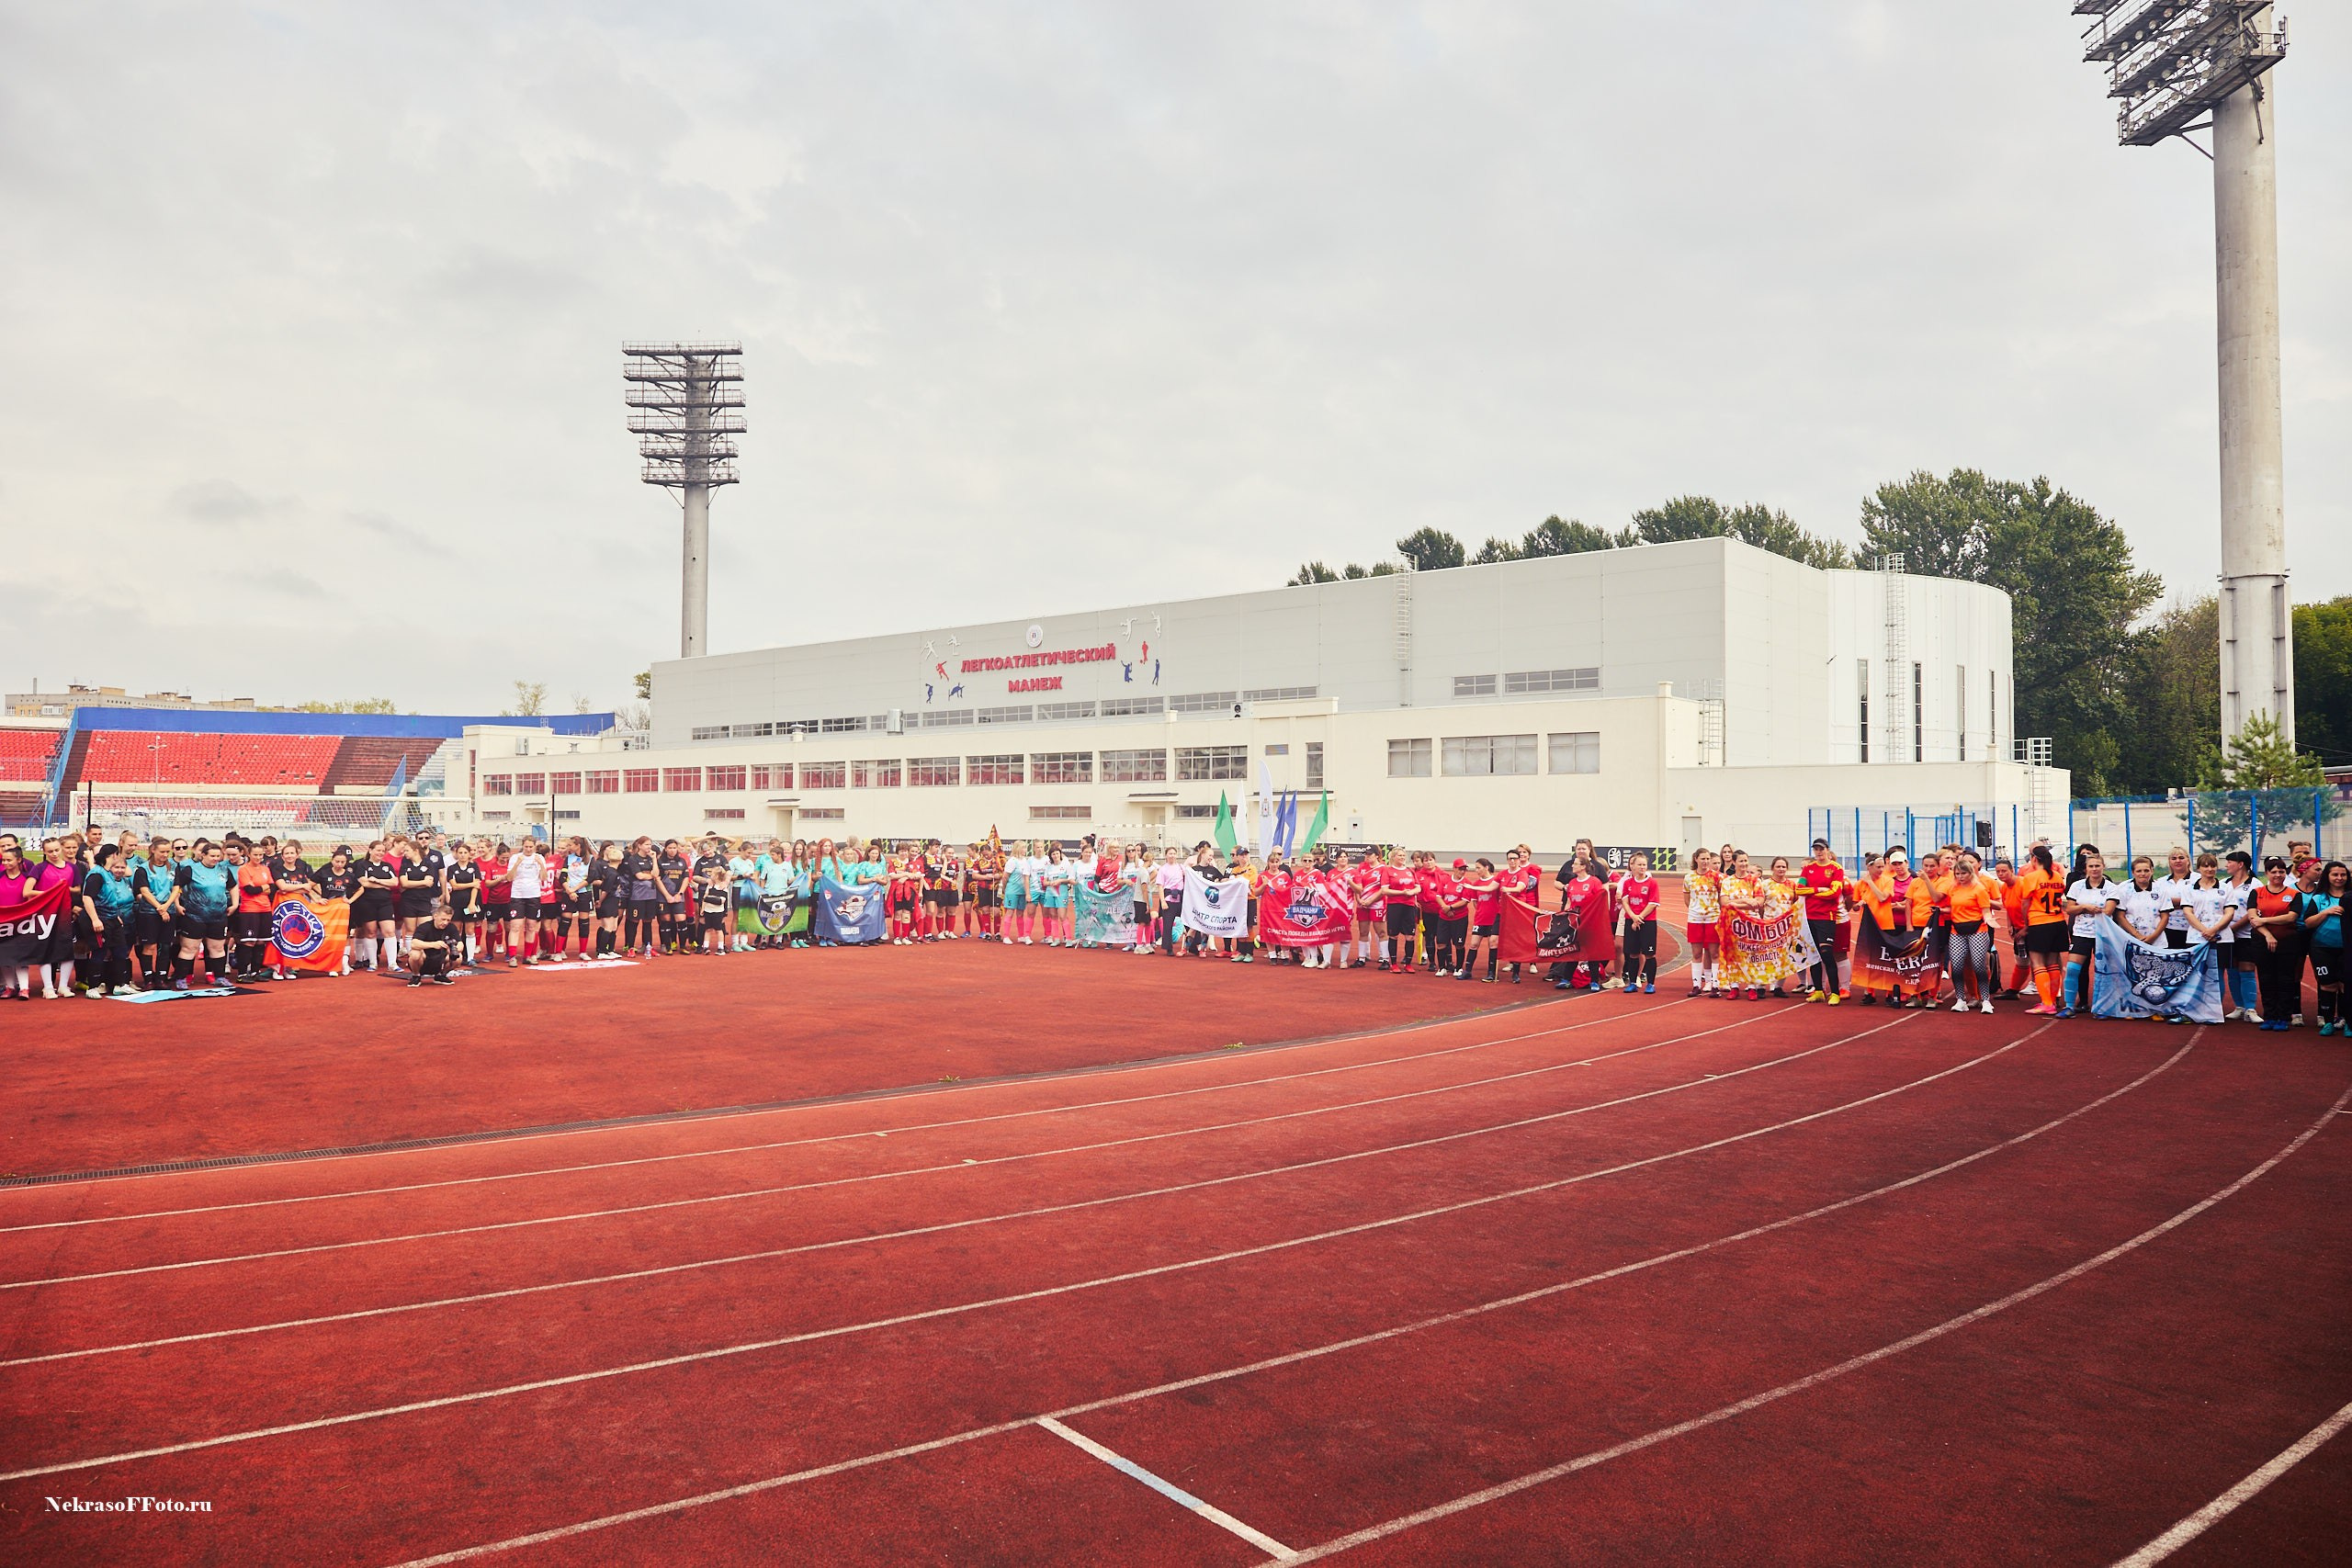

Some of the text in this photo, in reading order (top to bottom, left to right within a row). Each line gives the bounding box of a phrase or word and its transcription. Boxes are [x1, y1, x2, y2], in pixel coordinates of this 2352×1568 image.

[961, 643, 1116, 673] ЛЕГКОАТЛЕТИЧЕСКИЙ
[1008, 676, 1063, 694] МАНЕЖ
[2041, 892, 2062, 914] 15
[1210, 915, 1238, 924] СПОРТА
[1374, 909, 1384, 918] 15
[1731, 918, 1763, 941] ФМ
[1538, 944, 1577, 957] ПАНТЕРЫ
[2316, 965, 2328, 976] 20
